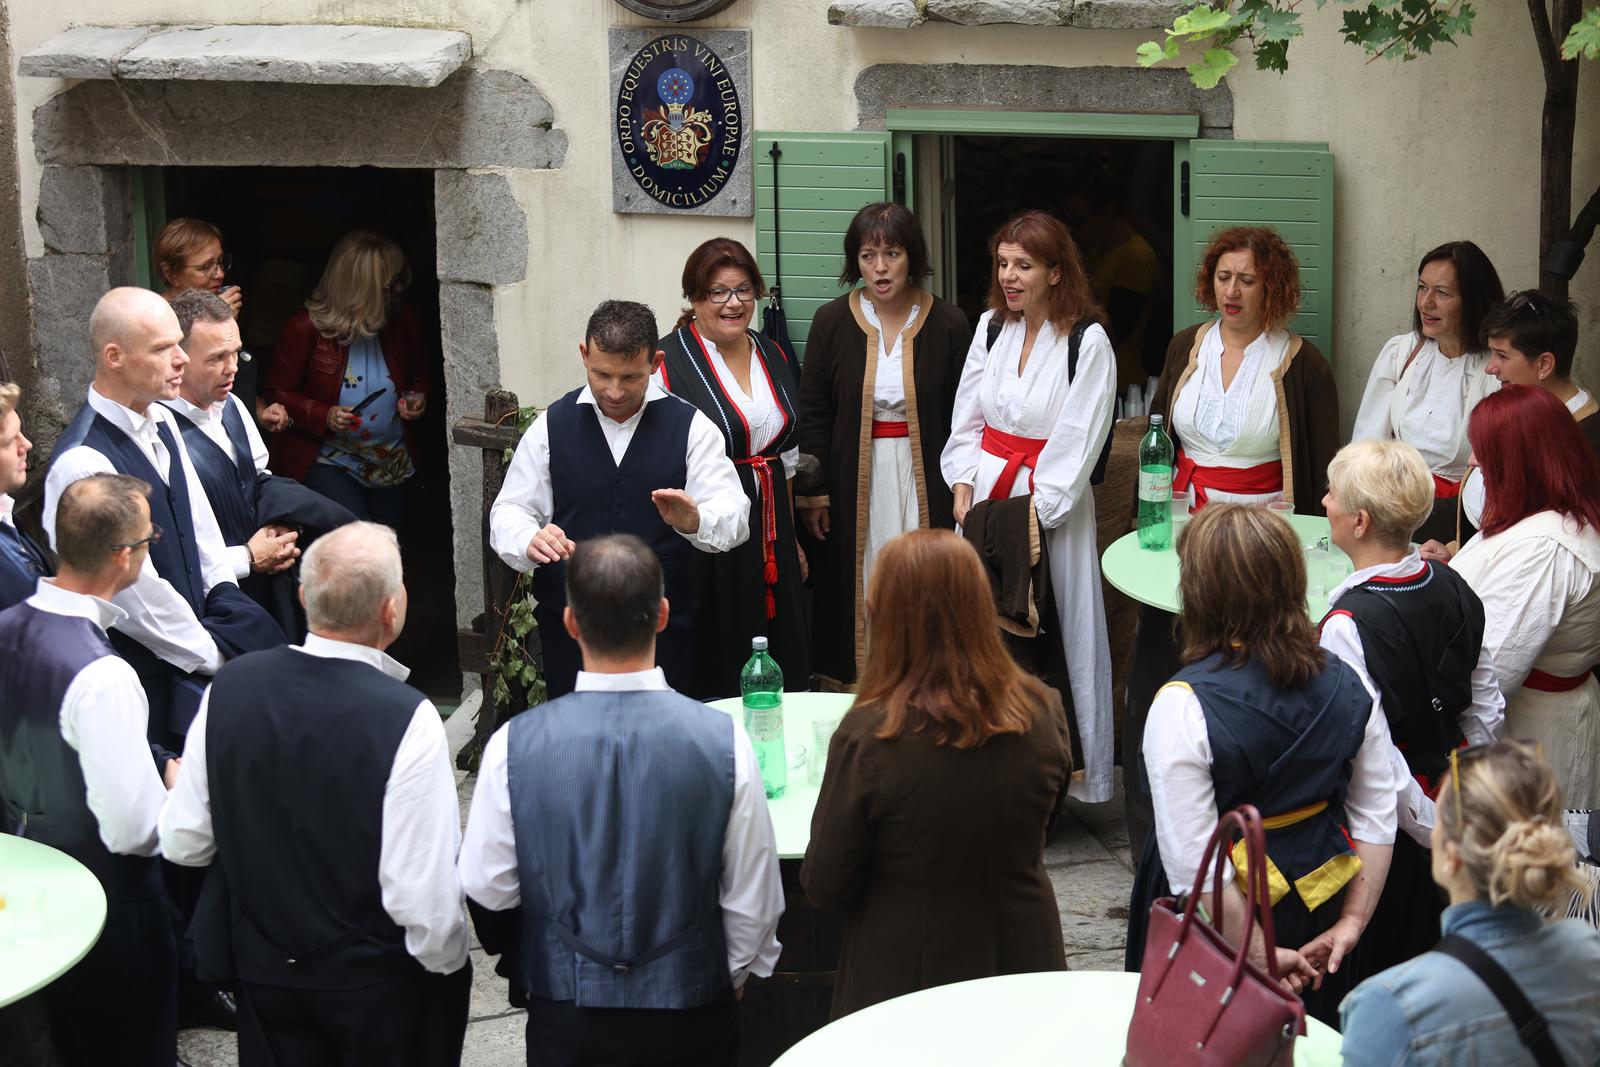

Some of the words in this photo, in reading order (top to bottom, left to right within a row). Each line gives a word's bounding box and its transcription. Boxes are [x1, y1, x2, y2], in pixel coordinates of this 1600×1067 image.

[623, 38, 688, 102] EQUESTRIS
[694, 44, 723, 77] VINI
[619, 105, 635, 153] ORDO
[717, 78, 738, 157] EUROPAE
[632, 165, 728, 206] DOMICILIUM
